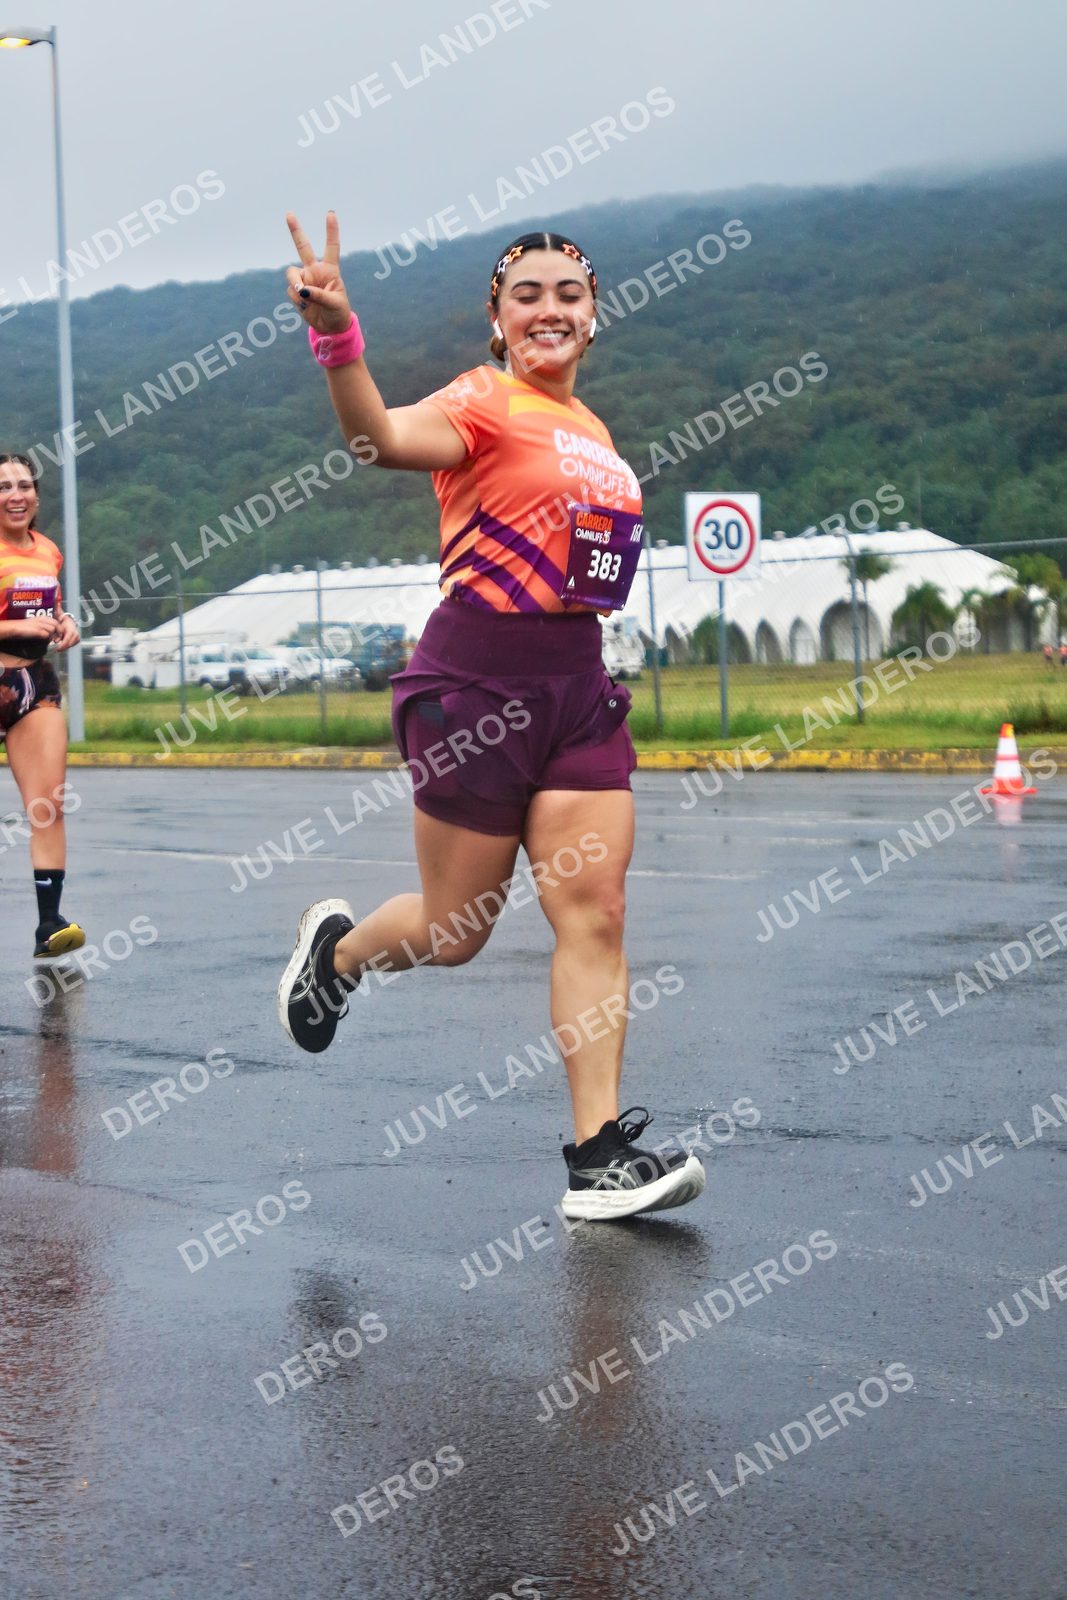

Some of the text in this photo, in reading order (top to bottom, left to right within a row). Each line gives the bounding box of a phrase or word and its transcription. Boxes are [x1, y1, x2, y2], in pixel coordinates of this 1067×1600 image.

[560, 457, 625, 496] OMNILIFE
[576, 511, 613, 532] CARRERA
[704, 519, 743, 550] 30
[587, 549, 622, 582] 383
